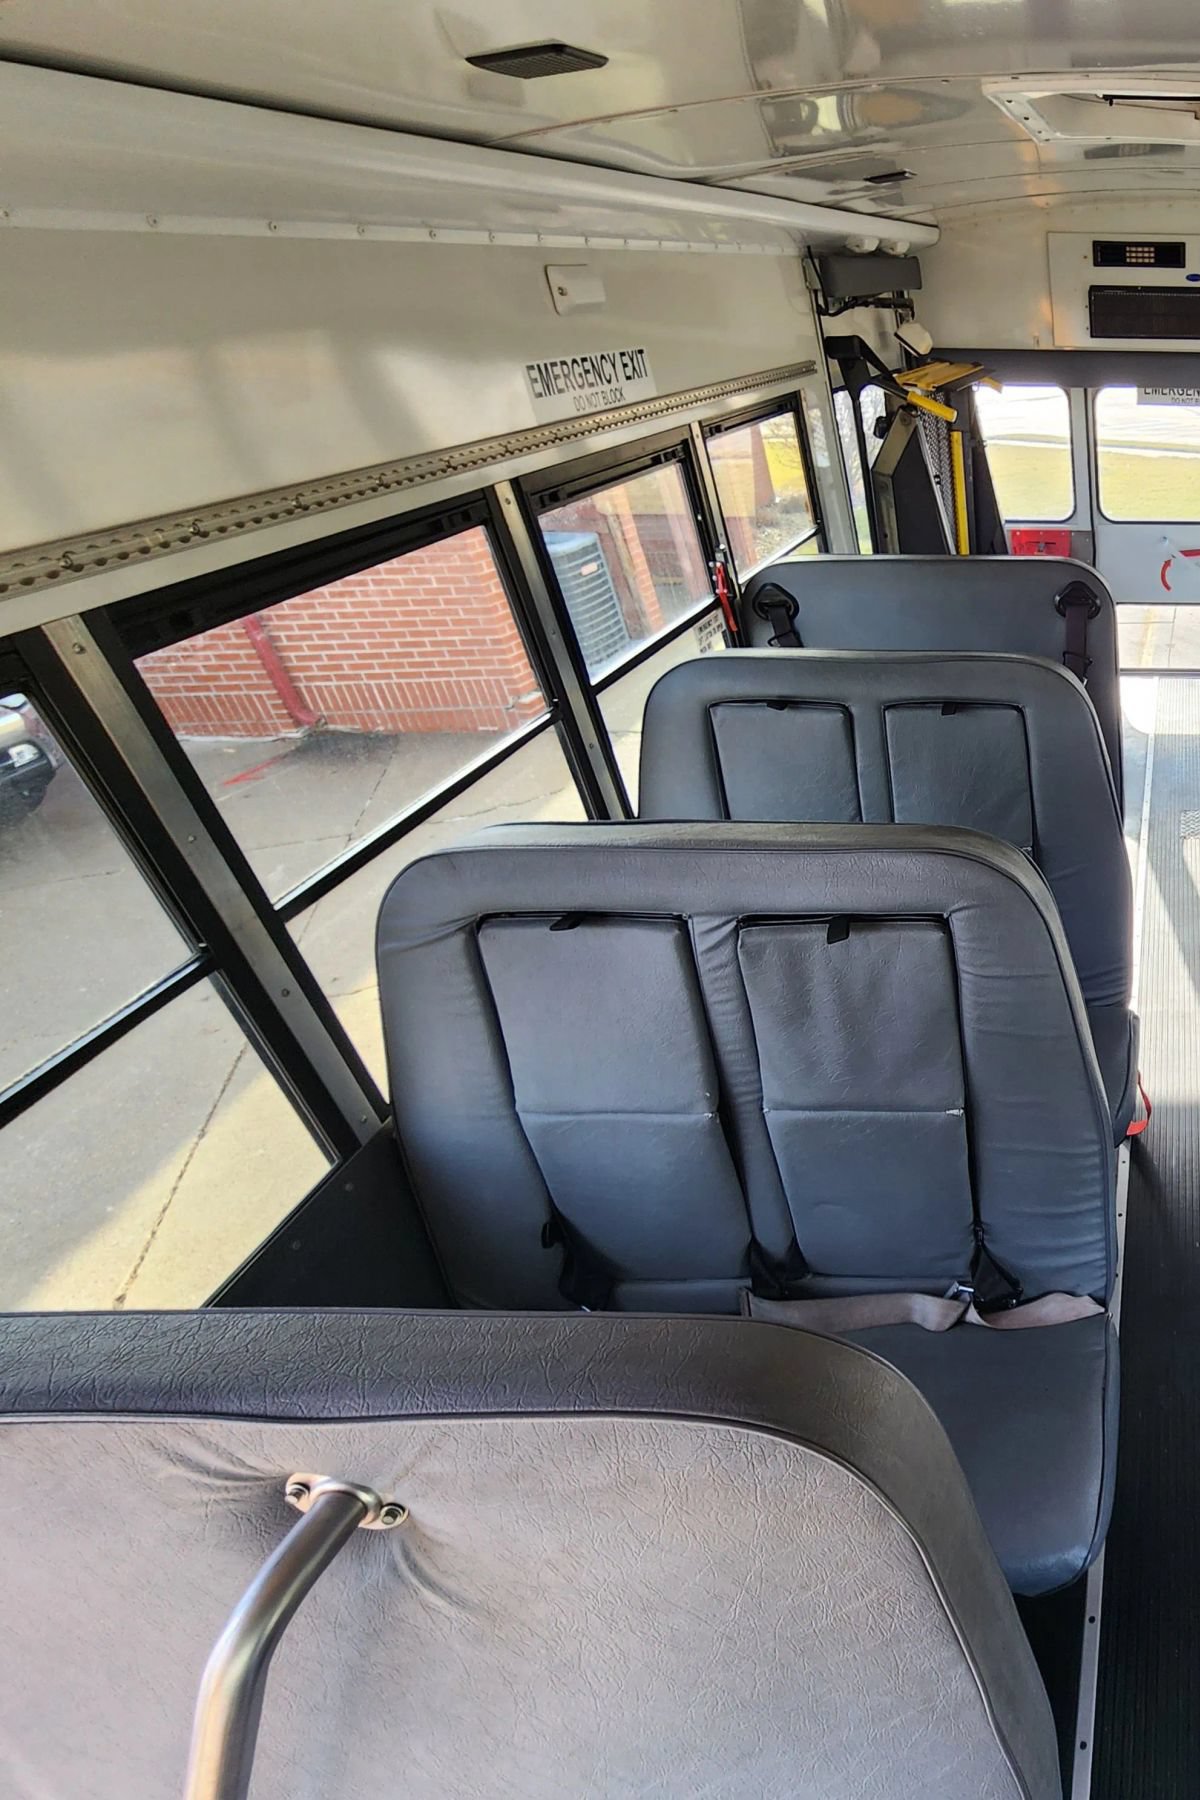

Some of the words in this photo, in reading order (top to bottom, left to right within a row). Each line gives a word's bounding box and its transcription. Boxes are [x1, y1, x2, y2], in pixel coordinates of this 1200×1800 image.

[526, 352, 619, 399] EMERGENCY
[619, 349, 648, 381] EXIT
[573, 395, 586, 412] DO
[586, 392, 601, 409] NOT
[600, 387, 626, 406] BLOCK
